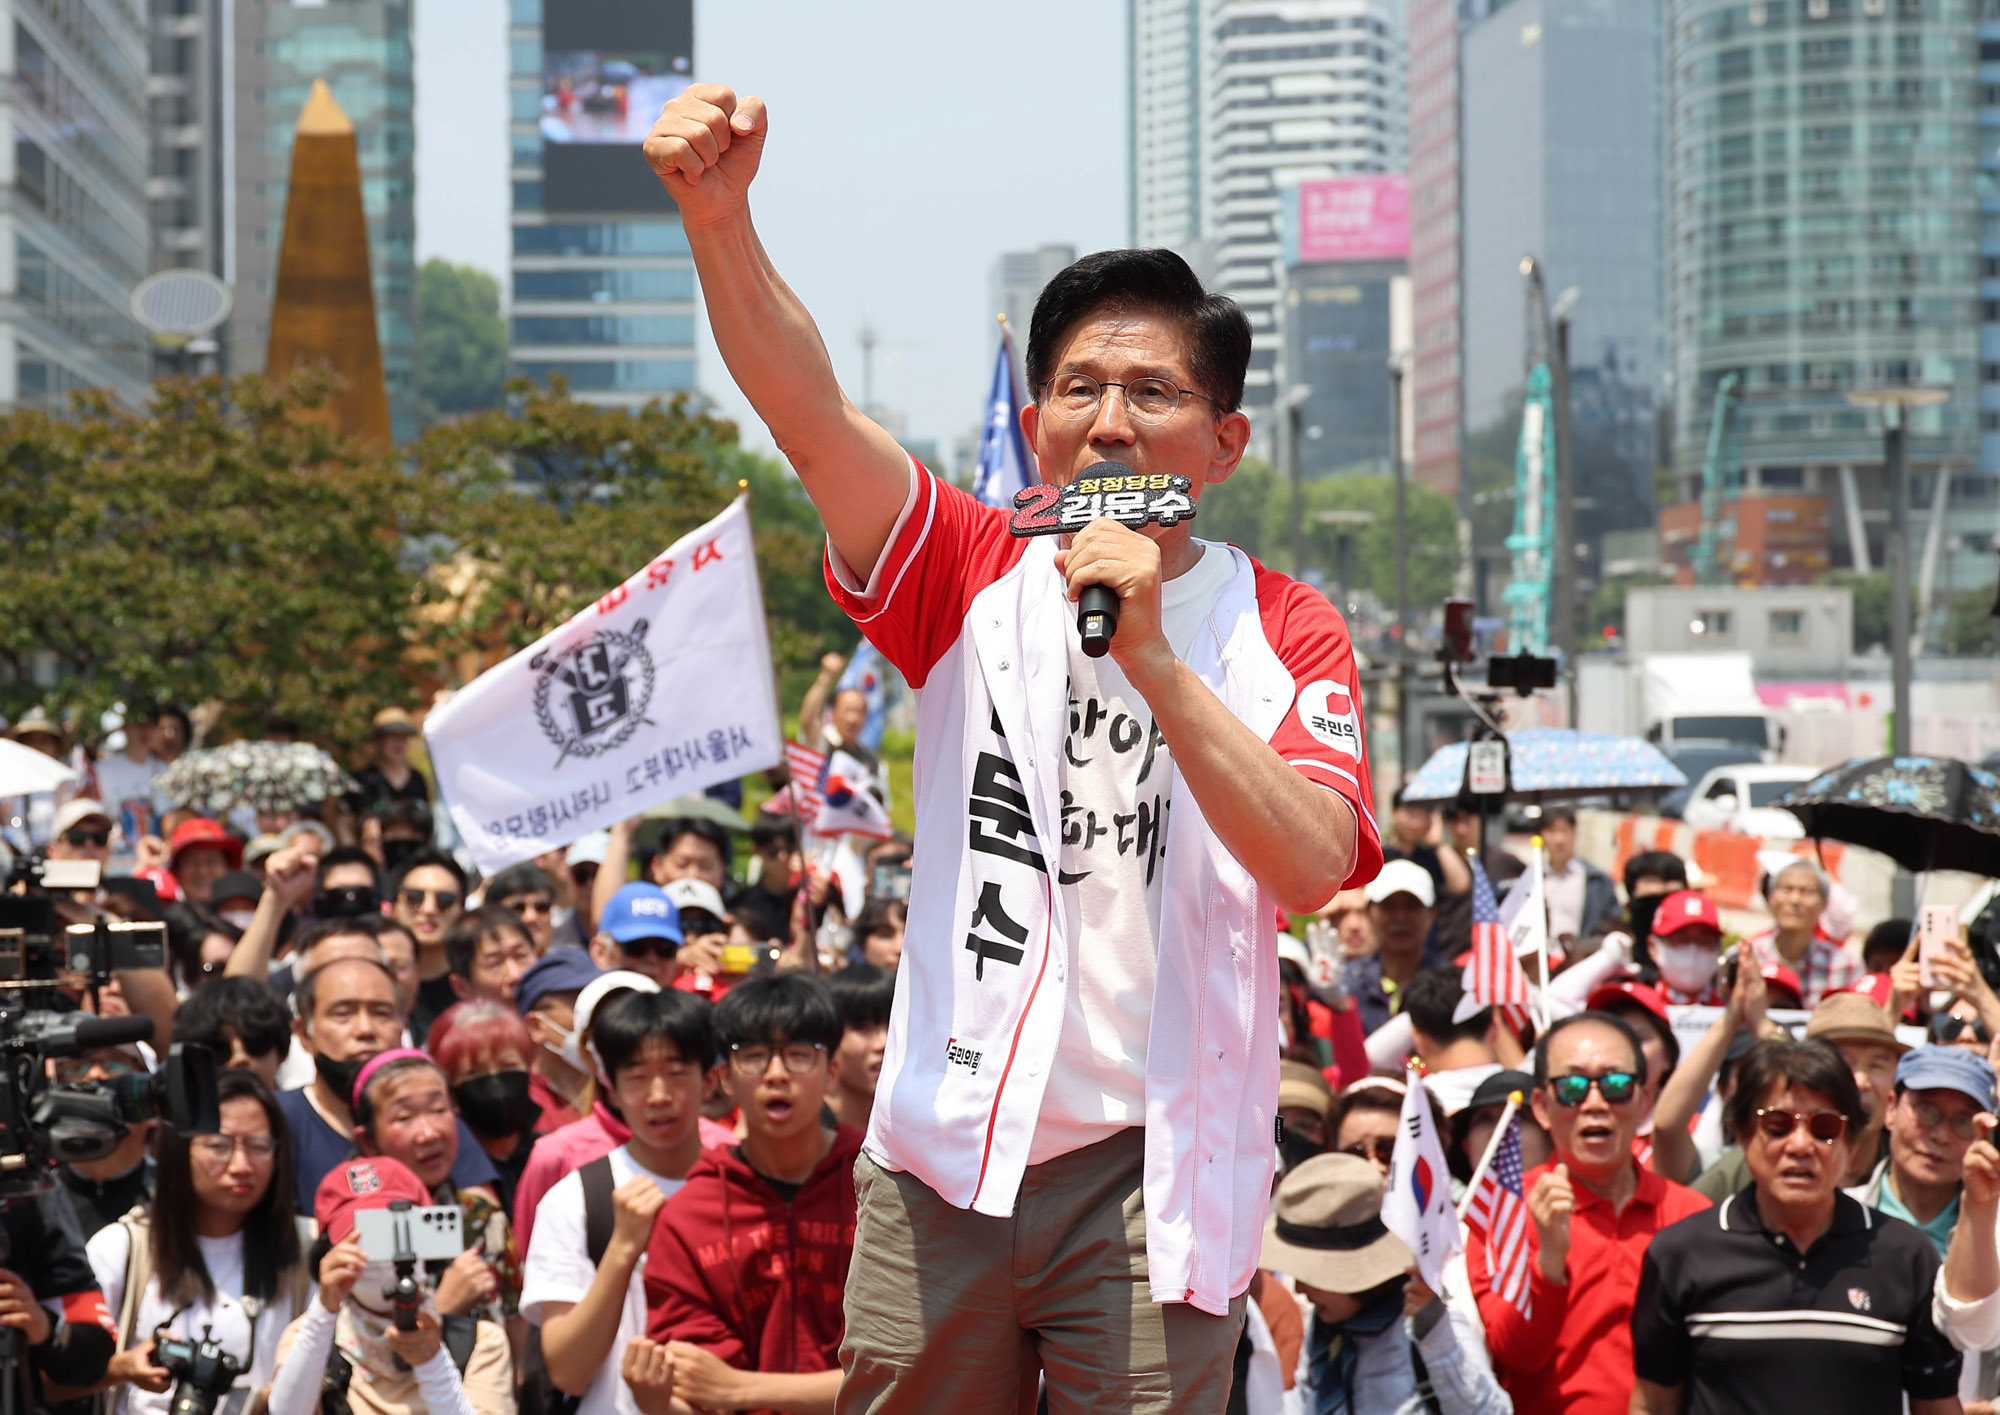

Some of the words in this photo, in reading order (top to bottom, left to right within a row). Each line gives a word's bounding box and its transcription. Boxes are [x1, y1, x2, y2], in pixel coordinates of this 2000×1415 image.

[1013, 484, 1061, 529] 2
[1060, 490, 1191, 524] 김문수
[965, 706, 1049, 983] 문수
[948, 1045, 983, 1070] 국민의힘
